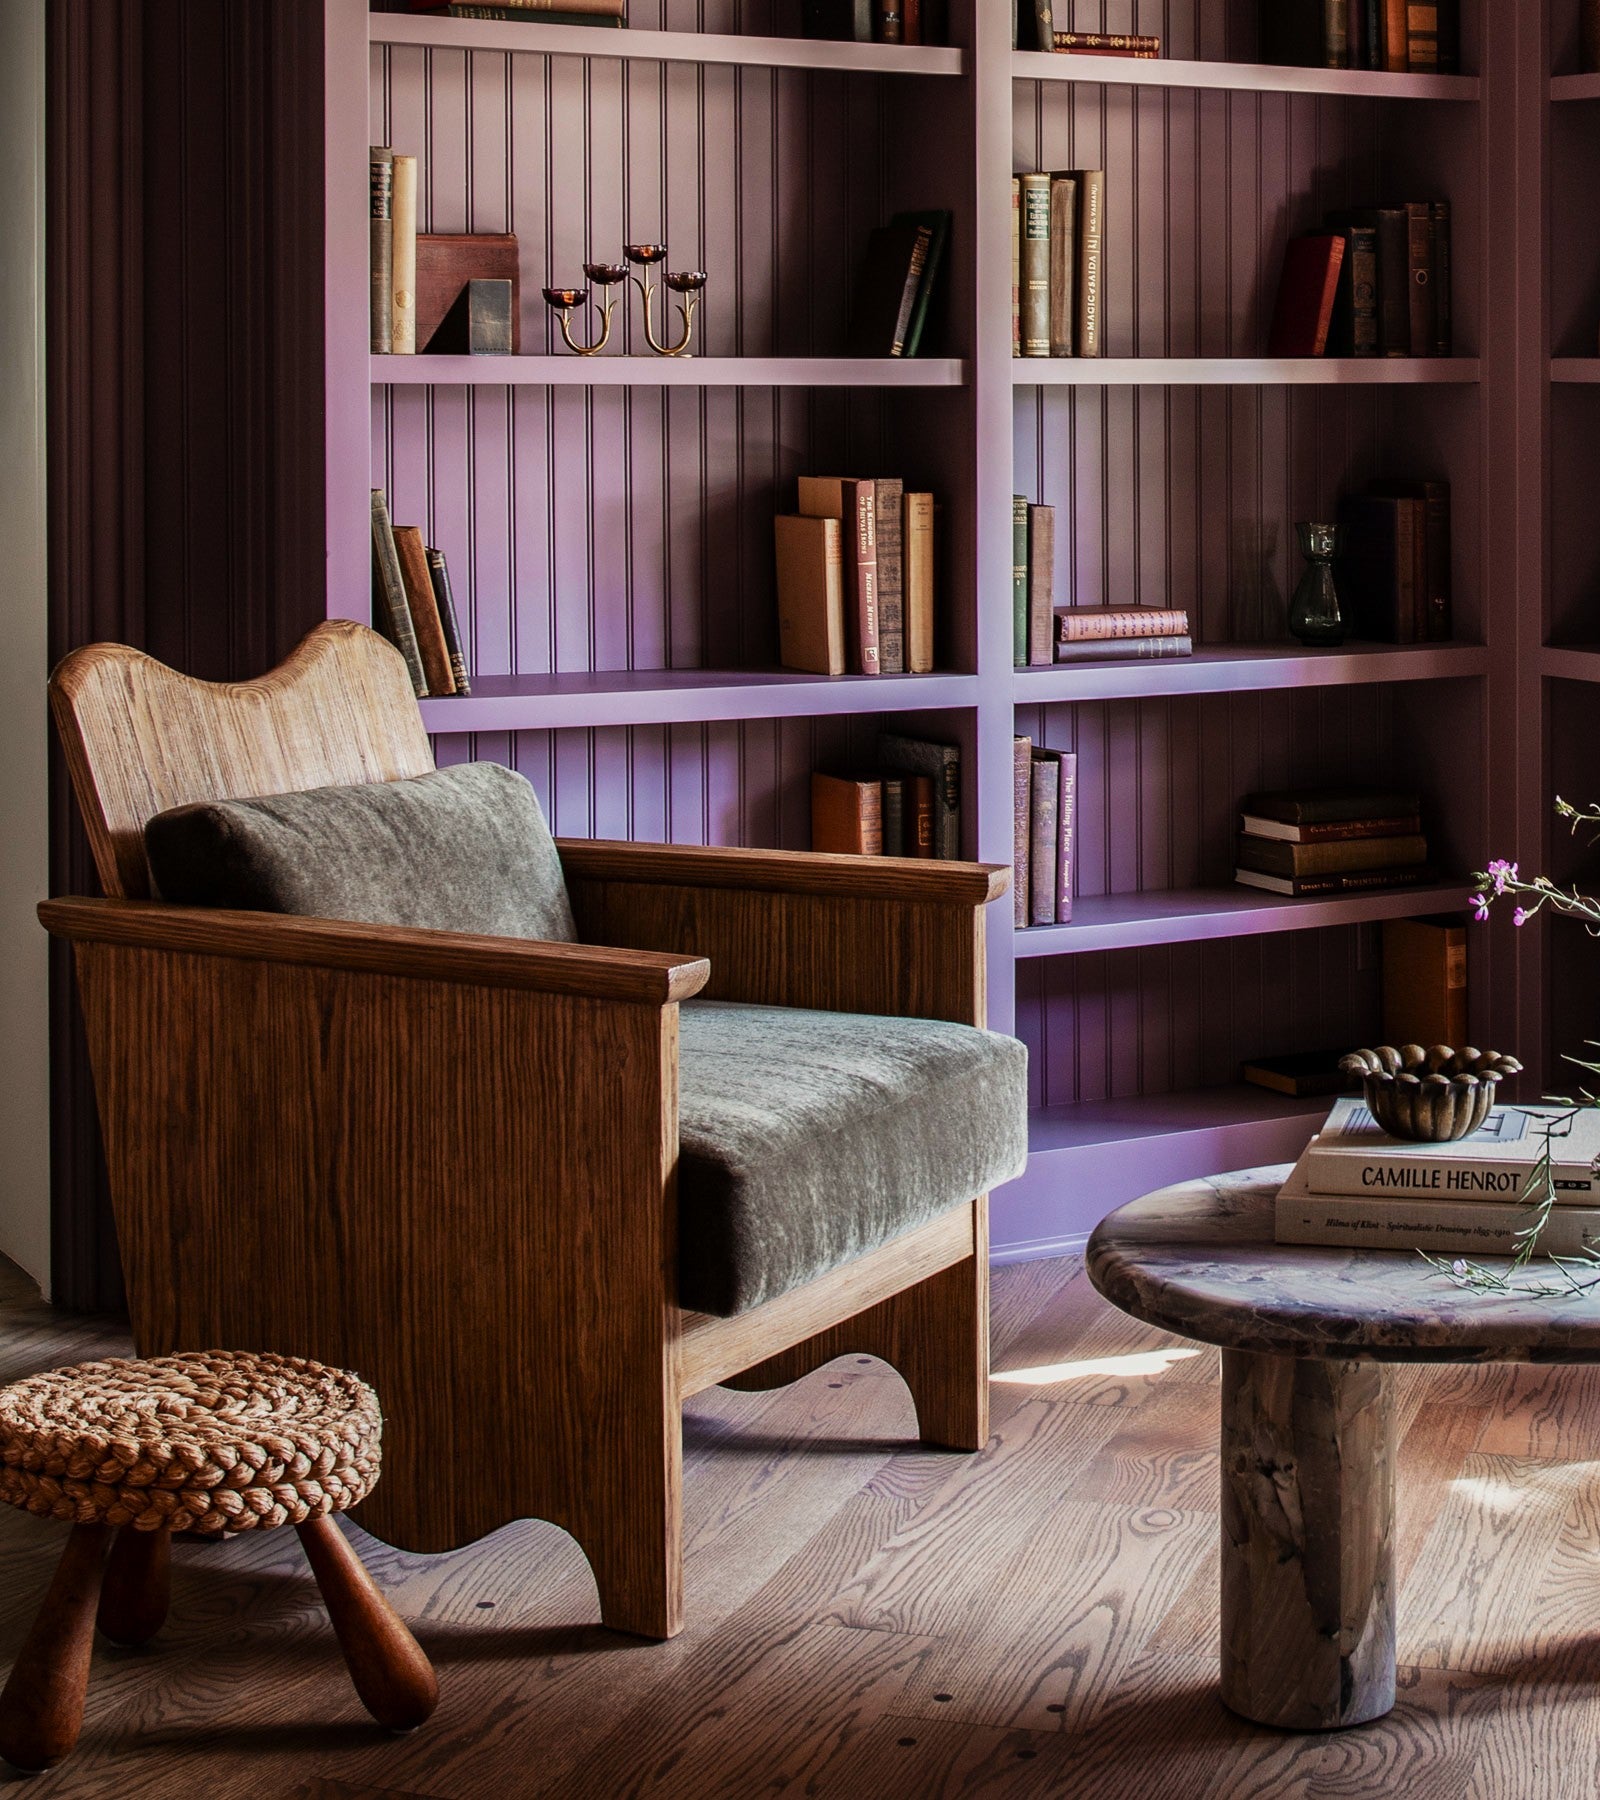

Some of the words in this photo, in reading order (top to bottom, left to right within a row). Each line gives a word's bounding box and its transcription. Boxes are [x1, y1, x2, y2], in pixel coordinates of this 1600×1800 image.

[1090, 183, 1099, 216] VASSANJI
[1088, 256, 1096, 288] SAIDA
[1087, 295, 1095, 331] MAGIC
[859, 507, 867, 532] SHIVAS
[865, 572, 873, 605] MICHAEL
[866, 605, 874, 636] MURPHY
[1065, 775, 1074, 792] The
[1063, 795, 1073, 825] Hiding
[1064, 828, 1073, 852] Place
[1342, 877, 1387, 888] PENINSULA
[1361, 1166, 1441, 1189] CAMILLE
[1446, 1169, 1522, 1192] HENROT
[1325, 1218, 1350, 1228] Hilma
[1350, 1219, 1360, 1231] af
[1360, 1219, 1379, 1229] Klint
[1435, 1224, 1471, 1236] Drawings
